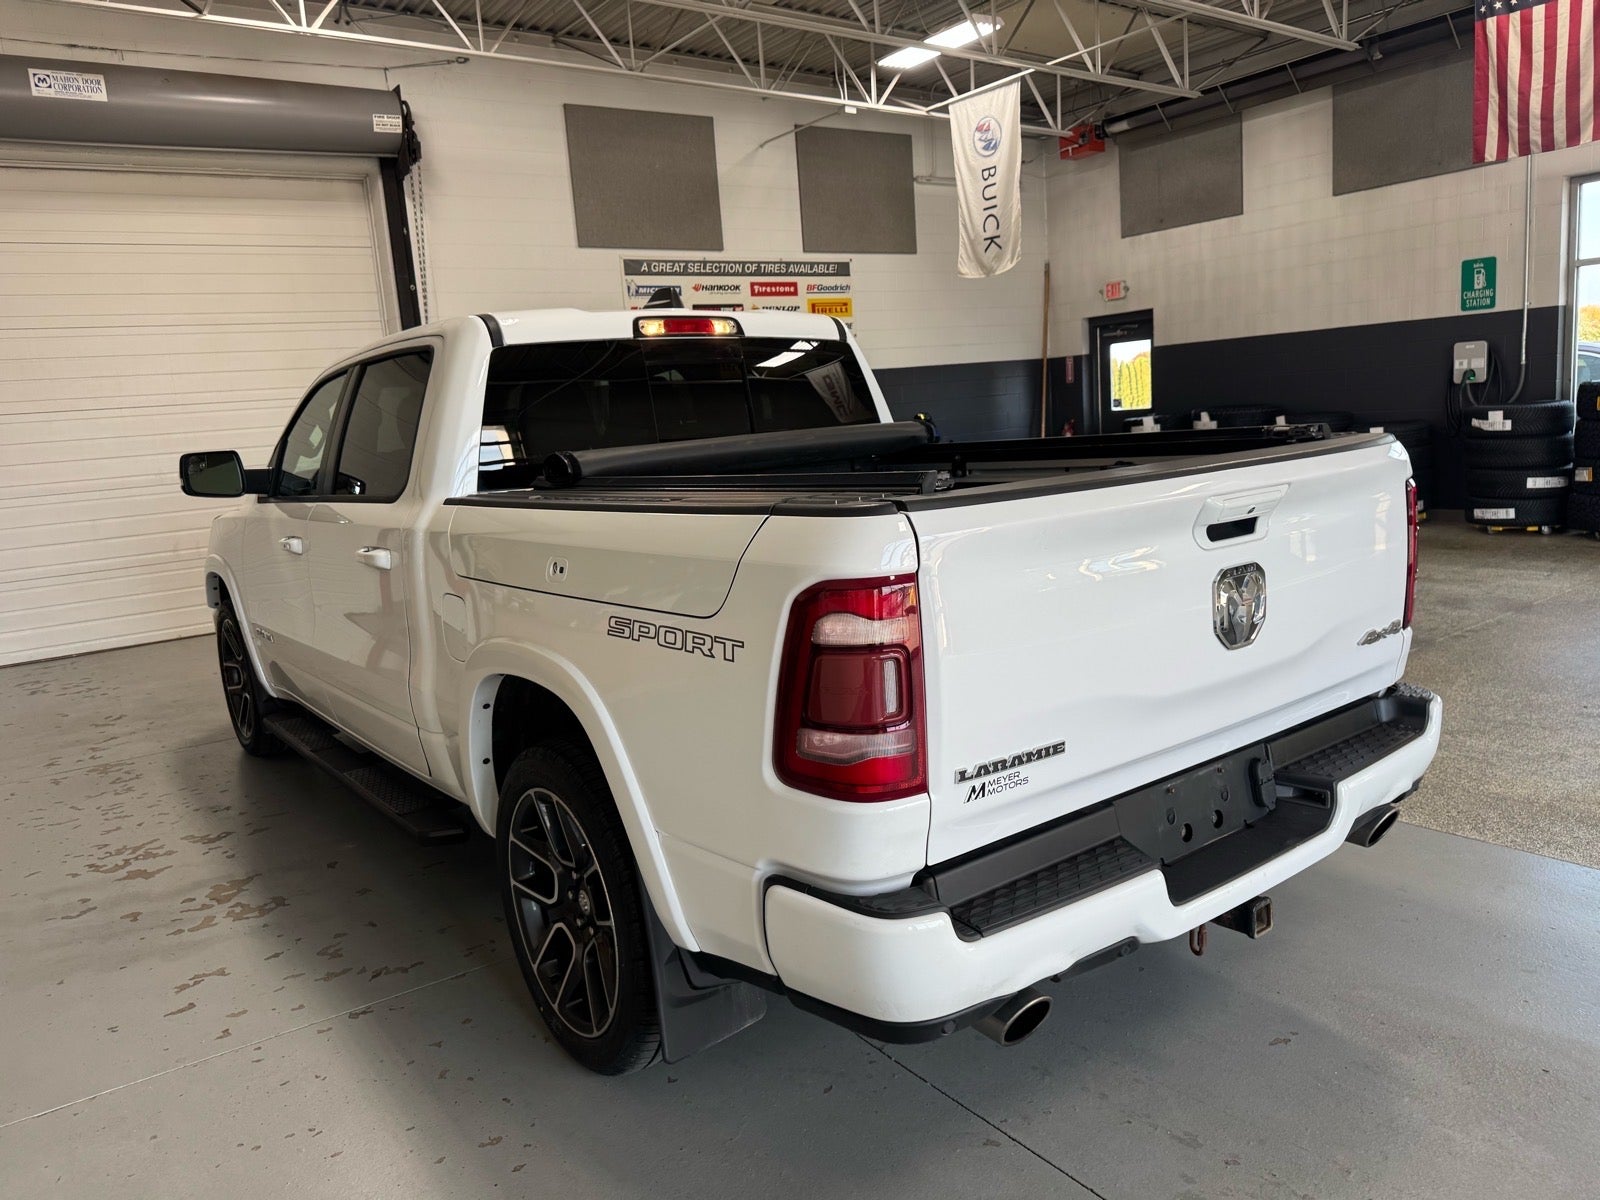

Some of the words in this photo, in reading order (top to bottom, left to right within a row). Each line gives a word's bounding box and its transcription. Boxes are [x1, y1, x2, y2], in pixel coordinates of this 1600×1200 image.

[51, 75, 79, 84] MAHON
[82, 78, 102, 86] DOOR
[53, 83, 103, 94] CORPORATION
[981, 165, 1002, 254] BUICK
[641, 262, 649, 273] A
[651, 262, 686, 273] GREAT
[687, 263, 742, 274] SELECTION
[745, 263, 758, 273] OF
[761, 263, 787, 274] TIRES
[788, 263, 838, 274] AVAILABLE!
[754, 285, 795, 295] Firestone
[806, 283, 851, 292] BFGoodrich
[1106, 282, 1120, 299] EXIT
[1463, 289, 1494, 300] CHARGING
[1466, 297, 1491, 308] STATION
[607, 615, 745, 663] SPORT
[954, 740, 1066, 785] LARAMIE
[987, 771, 1021, 788] MEYER
[987, 776, 1029, 797] MOTORS
